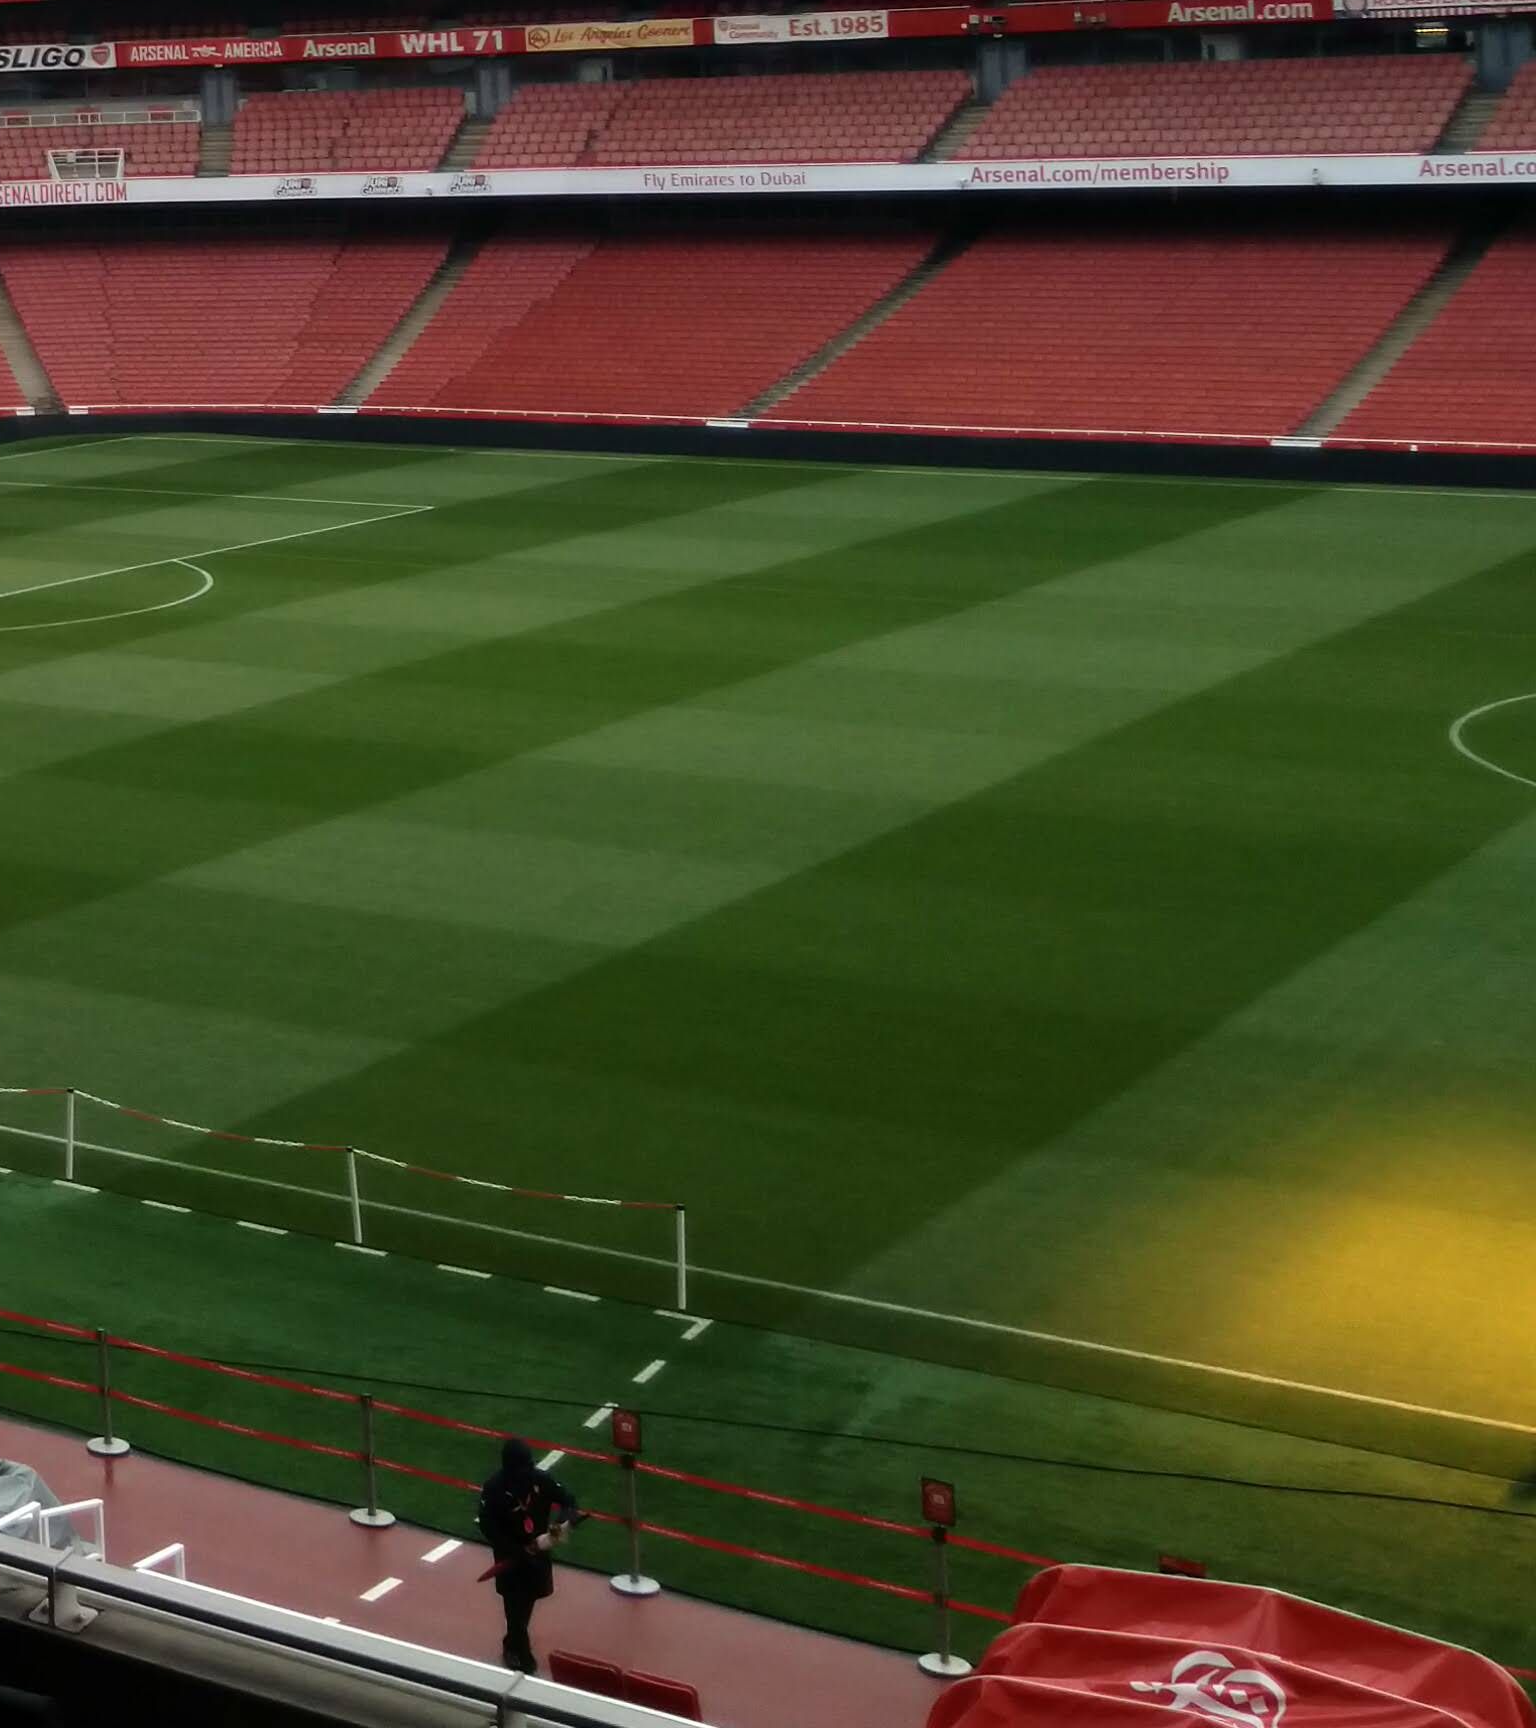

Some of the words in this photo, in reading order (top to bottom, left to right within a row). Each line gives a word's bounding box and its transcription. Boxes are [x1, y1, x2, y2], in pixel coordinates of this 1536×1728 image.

[1168, 0, 1313, 23] Arsenal.com
[131, 44, 189, 62] ARSENAL
[224, 41, 283, 59] AMERICA
[303, 37, 375, 58] Arsenal
[400, 32, 464, 54] WHL
[473, 30, 503, 51] 71
[644, 173, 666, 191] Fly
[671, 171, 735, 187] Emirates
[740, 174, 755, 186] to
[760, 172, 806, 186] Dubai
[971, 162, 1230, 183] Arsenal.com/membership
